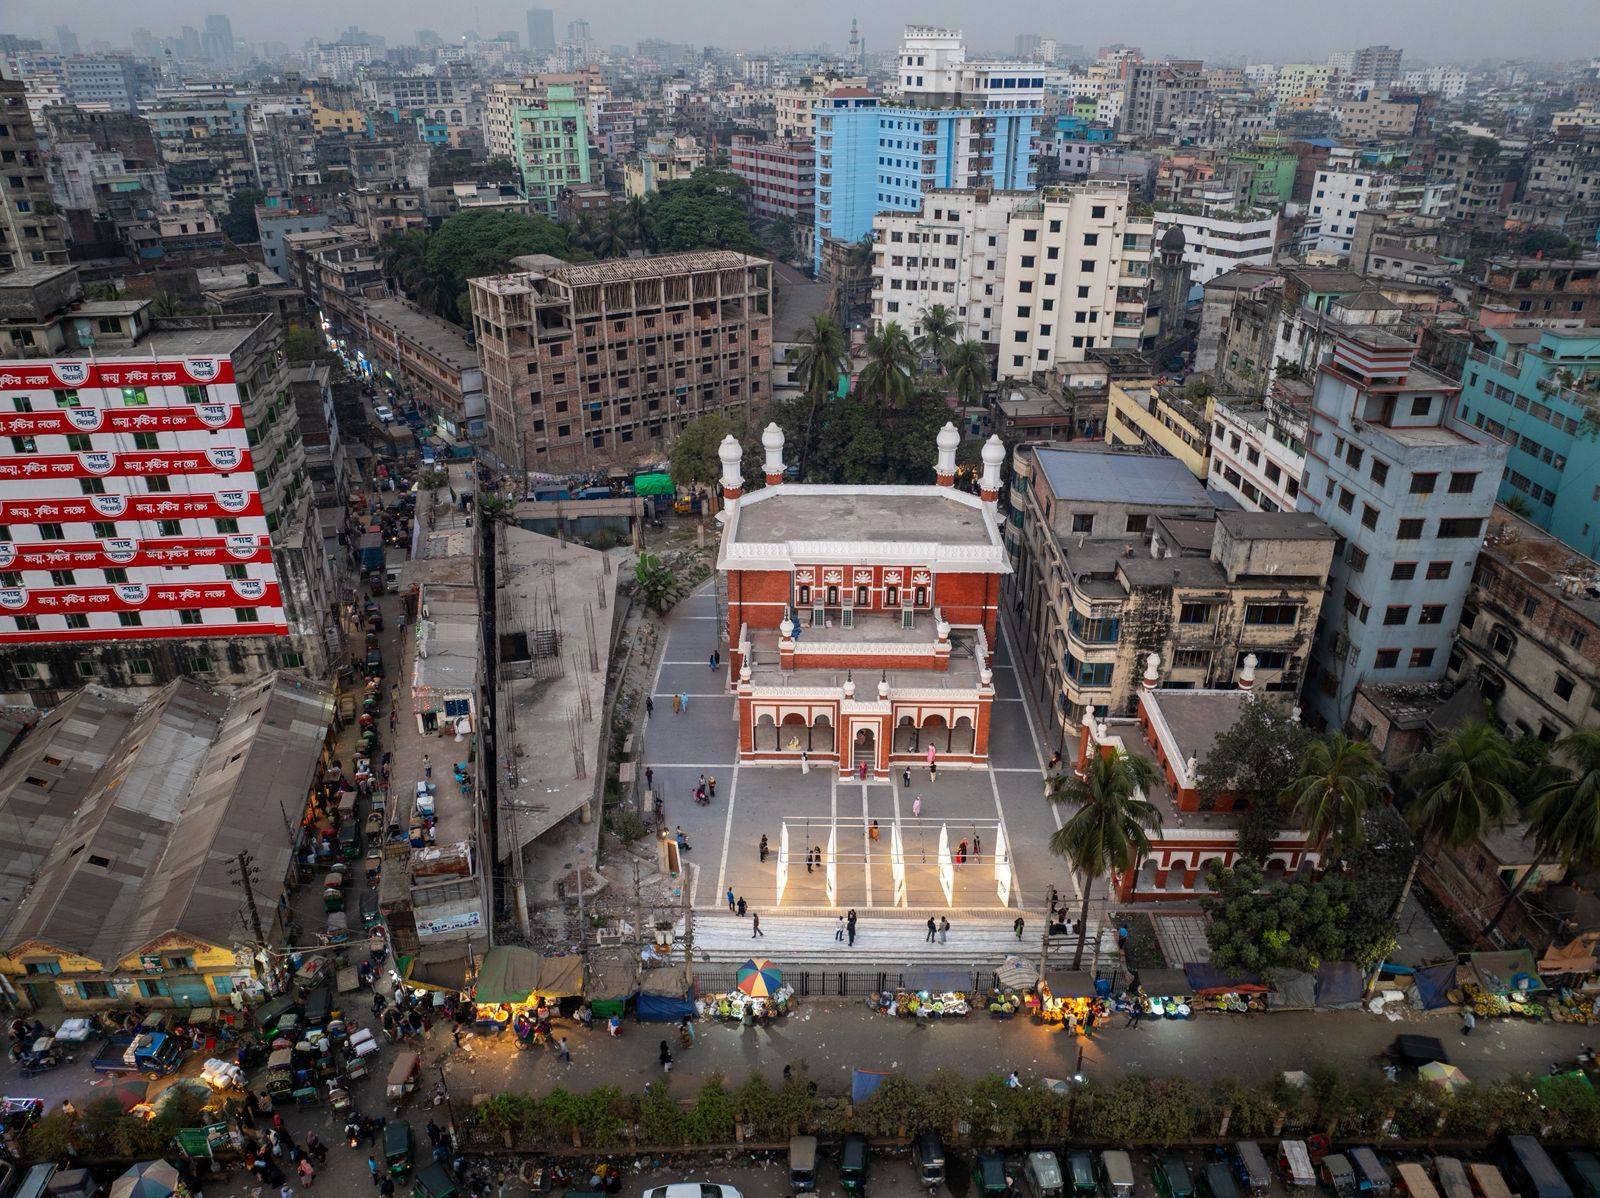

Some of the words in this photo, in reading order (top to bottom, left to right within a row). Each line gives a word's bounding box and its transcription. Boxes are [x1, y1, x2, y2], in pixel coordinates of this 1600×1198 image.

[125, 371, 148, 383] সৃষ্টির
[8, 418, 34, 432] সৃষ্টির
[133, 415, 157, 428] সৃষ্টির
[22, 462, 47, 475] সৃষ্টির
[145, 458, 169, 472] সৃষ্টির
[34, 505, 59, 518] সৃষ্টির
[156, 501, 180, 514] সৃষ্টির
[46, 549, 70, 564] সৃষ্টির
[166, 546, 189, 560] সৃষ্টির
[61, 593, 86, 606] সৃষ্টির
[179, 589, 201, 601] সৃষ্টির
